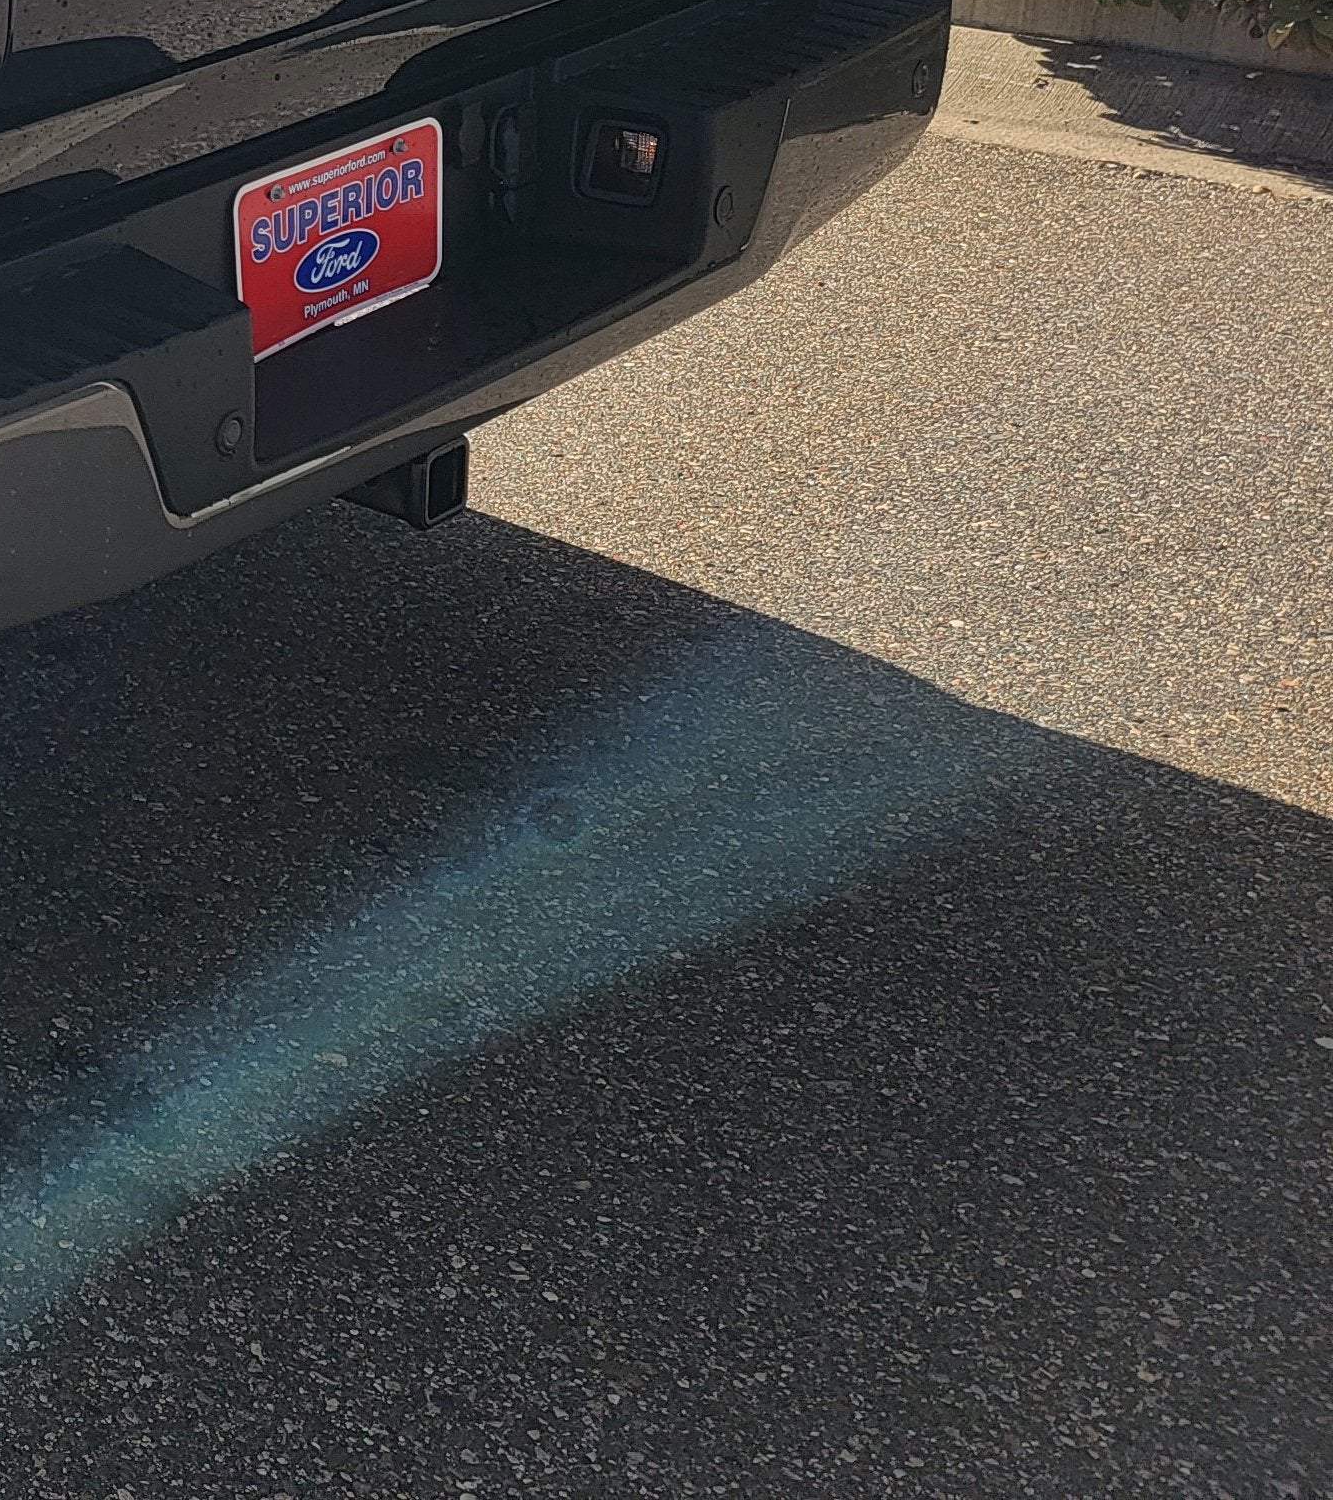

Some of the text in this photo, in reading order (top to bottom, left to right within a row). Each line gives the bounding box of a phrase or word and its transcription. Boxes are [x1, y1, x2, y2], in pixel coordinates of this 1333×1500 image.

[288, 149, 386, 196] www.superiorford.com
[251, 158, 425, 264] SUPERIOR
[310, 237, 363, 284] Ford
[303, 287, 351, 320] Plymouth,
[352, 279, 370, 297] MN
